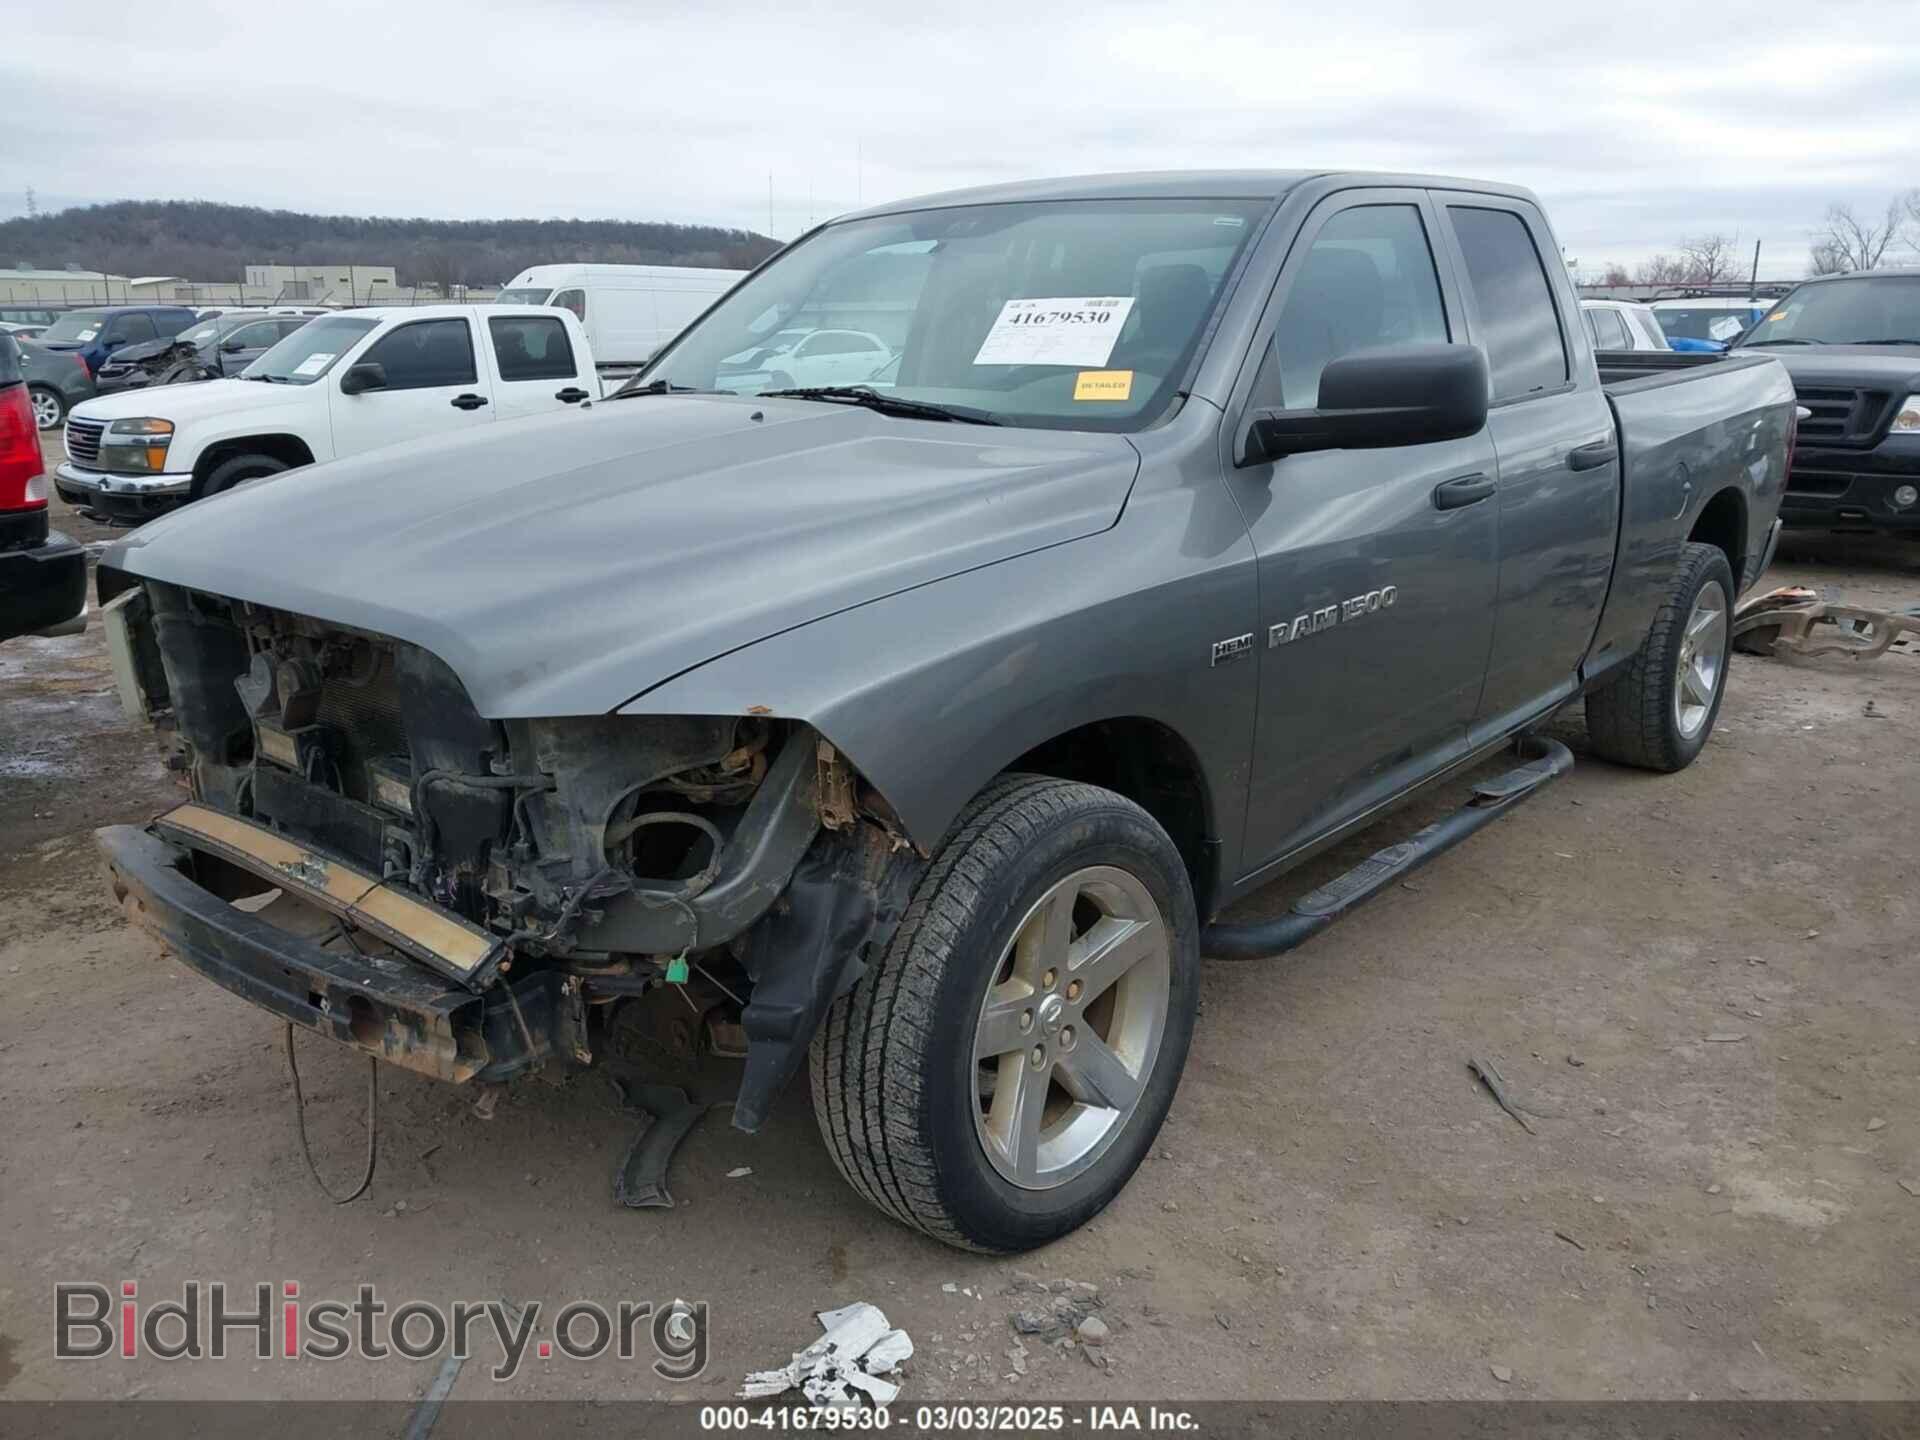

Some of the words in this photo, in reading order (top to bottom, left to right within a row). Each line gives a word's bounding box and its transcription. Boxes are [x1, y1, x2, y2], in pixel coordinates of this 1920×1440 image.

[1009, 311, 1111, 325] 41679530
[1268, 604, 1338, 648] RAM
[1342, 585, 1398, 622] 1500
[1211, 632, 1254, 667] HEMI
